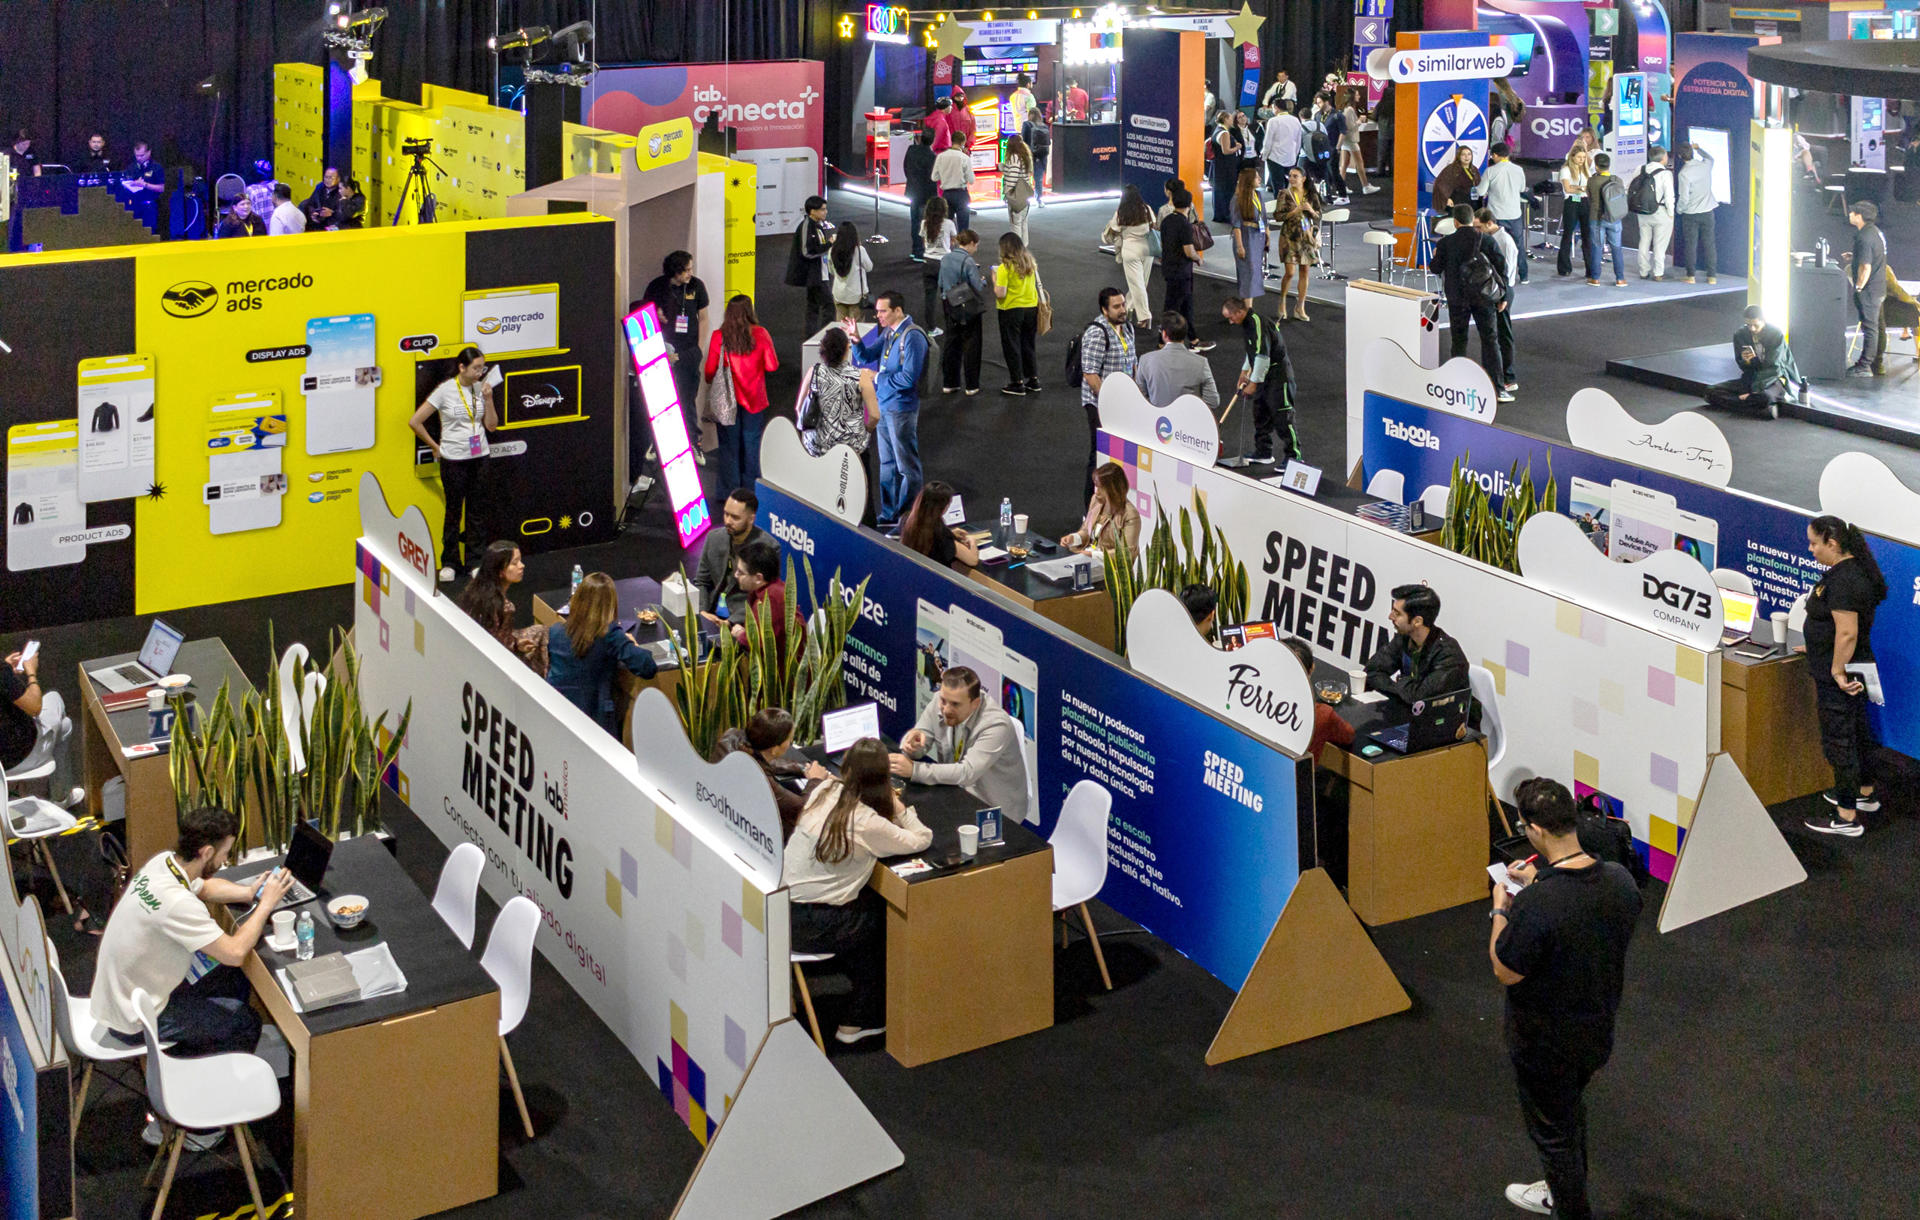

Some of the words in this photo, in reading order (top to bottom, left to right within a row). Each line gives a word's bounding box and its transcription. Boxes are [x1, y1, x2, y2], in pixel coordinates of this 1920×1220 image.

[1418, 52, 1505, 72] similarweb
[1643, 56, 1662, 65] QSIC
[1683, 86, 1722, 95] ESTRATEGIA
[1723, 89, 1748, 98] DIGITAL
[1693, 78, 1727, 88] POTENCIA
[1140, 118, 1167, 129] similarweb
[1531, 117, 1584, 139] QSIC
[1092, 146, 1117, 154] AGENCIA
[1126, 132, 1135, 141] LOS
[1136, 134, 1157, 144] MEJORES
[1158, 137, 1174, 147] DATOS
[1127, 141, 1139, 150] PARA
[1140, 143, 1164, 154] ENTENDER
[1126, 150, 1150, 160] MERCADO
[1154, 155, 1173, 165] CRECER
[1132, 159, 1137, 167] EL
[1138, 161, 1155, 171] MUNDO
[1156, 164, 1175, 174] DIGITAL
[226, 272, 313, 294] mercado
[226, 295, 263, 312] ads
[501, 311, 544, 323] mercado
[501, 323, 521, 334] play
[252, 350, 286, 361] DISPLAY
[288, 347, 306, 358] ADS
[412, 338, 433, 347] CLIPS
[1426, 383, 1487, 413] cognify
[1174, 429, 1211, 451] element
[1382, 417, 1440, 450] Taboola
[501, 445, 517, 454] ADS
[326, 467, 352, 475] mercado
[840, 458, 849, 494] GOLDFISH
[326, 494, 341, 502] pago
[59, 529, 103, 544] PRODUCT
[105, 528, 124, 538] ADS
[768, 512, 815, 556] Taboola
[1618, 538, 1642, 551] Device
[1624, 534, 1644, 545] Make
[1644, 540, 1659, 550] Any
[398, 531, 429, 577] GREY
[1746, 539, 1758, 550] La
[1760, 544, 1789, 560] nueva
[1790, 554, 1797, 565] y
[1746, 552, 1800, 575] plataforma
[1262, 530, 1376, 612] SPEED
[1746, 563, 1759, 574] de
[1760, 567, 1800, 589] Taboola,
[1643, 572, 1712, 620] DG73
[1760, 591, 1770, 602] IA
[1771, 596, 1778, 606] y
[1763, 581, 1800, 598] nuestra
[1653, 609, 1701, 632] COMPANY
[849, 654, 867, 675] allá
[868, 664, 882, 682] de
[859, 680, 867, 696] y
[868, 685, 897, 712] social
[1228, 663, 1304, 732] Ferrer
[1061, 689, 1071, 704] La
[1072, 695, 1098, 719] nueva
[1098, 710, 1105, 723] y
[1105, 712, 1145, 744] poderosa
[461, 680, 534, 793] SPEED
[1061, 704, 1106, 737] plataforma
[1107, 730, 1156, 766] publicitaria
[1061, 719, 1072, 734] de
[1073, 724, 1108, 755] Taboola,
[1108, 745, 1154, 780] impulsada
[1061, 735, 1075, 751] por
[1076, 740, 1108, 767] nuestra
[1109, 759, 1154, 795] tecnología
[1061, 747, 1072, 762] de
[1072, 753, 1082, 767] IA
[1082, 762, 1089, 774] y
[1089, 761, 1109, 784] data
[1110, 775, 1137, 800] única.
[1203, 749, 1244, 785] SPEED
[1202, 767, 1264, 814] MEETING
[461, 739, 574, 901] MEETING
[696, 781, 774, 854] goodhumans
[1114, 816, 1121, 827] a
[1122, 820, 1151, 845] escala
[1123, 832, 1156, 862] nuestro
[1121, 859, 1138, 880] allá
[1140, 872, 1151, 887] de
[1152, 881, 1184, 908] nativo.
[1146, 863, 1164, 881] que
[443, 795, 486, 852] Conecta
[487, 846, 509, 879] con
[511, 866, 523, 894] tu
[565, 929, 607, 987] digital
